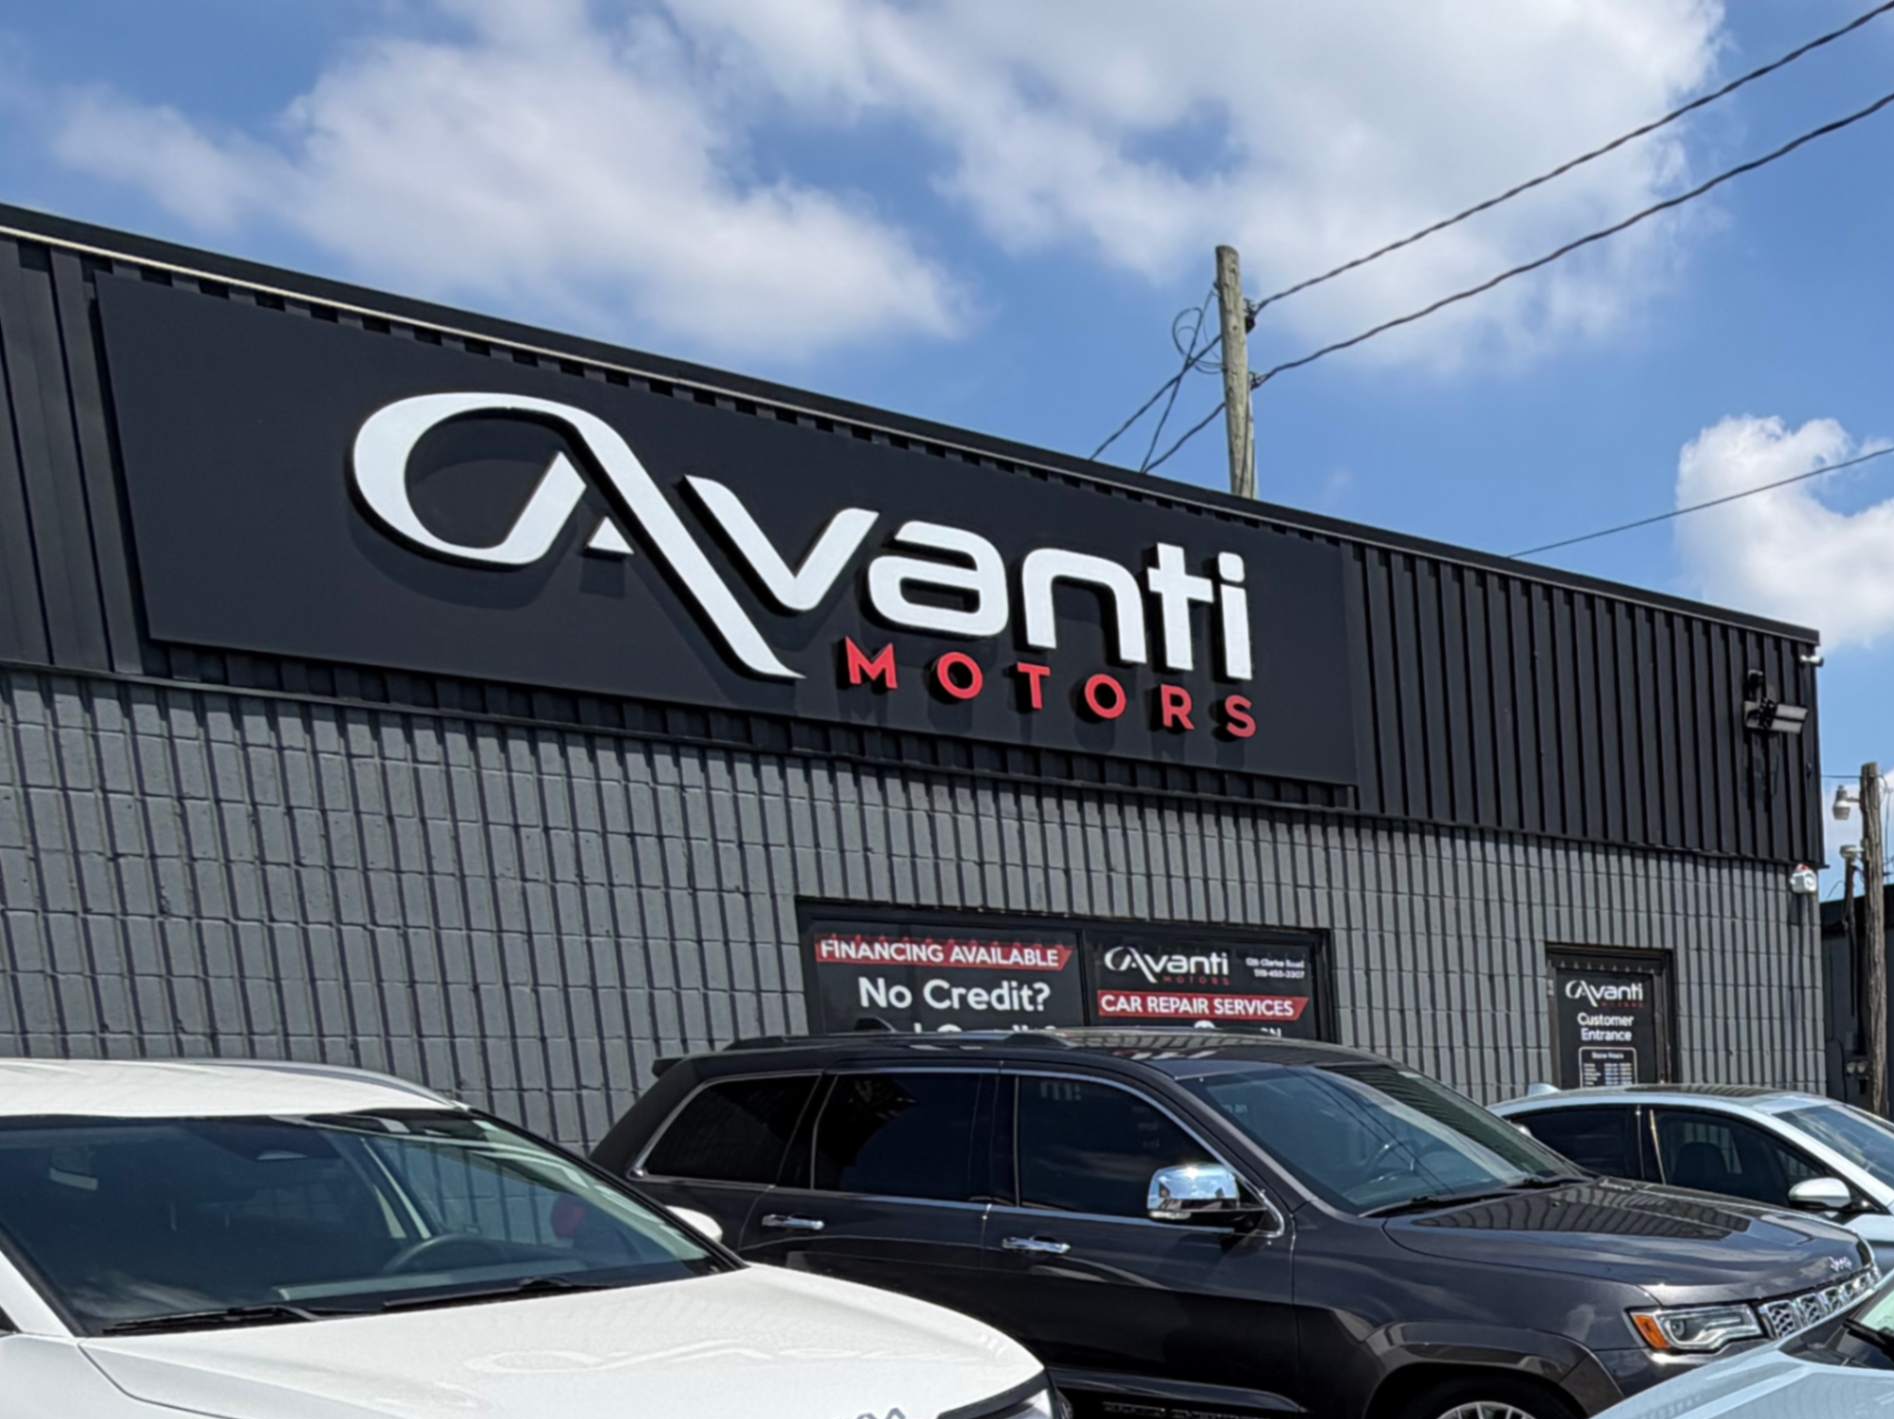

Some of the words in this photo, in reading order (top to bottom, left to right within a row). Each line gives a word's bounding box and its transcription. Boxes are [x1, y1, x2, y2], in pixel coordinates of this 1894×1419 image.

[353, 391, 1253, 681] Avanti
[845, 636, 1257, 738] MOTORS
[820, 939, 945, 963] FINANCING
[950, 945, 1060, 968] AVAILABLE
[1104, 946, 1230, 984] Avanti
[857, 976, 913, 1009] No
[922, 978, 1052, 1012] Credit?
[1100, 994, 1143, 1013] CAR
[1147, 995, 1210, 1015] REPAIR
[1214, 998, 1294, 1017] SERVICES
[1565, 979, 1644, 1007] Avanti
[1577, 1012, 1635, 1028] Customer
[1580, 1028, 1633, 1042] Entrance
